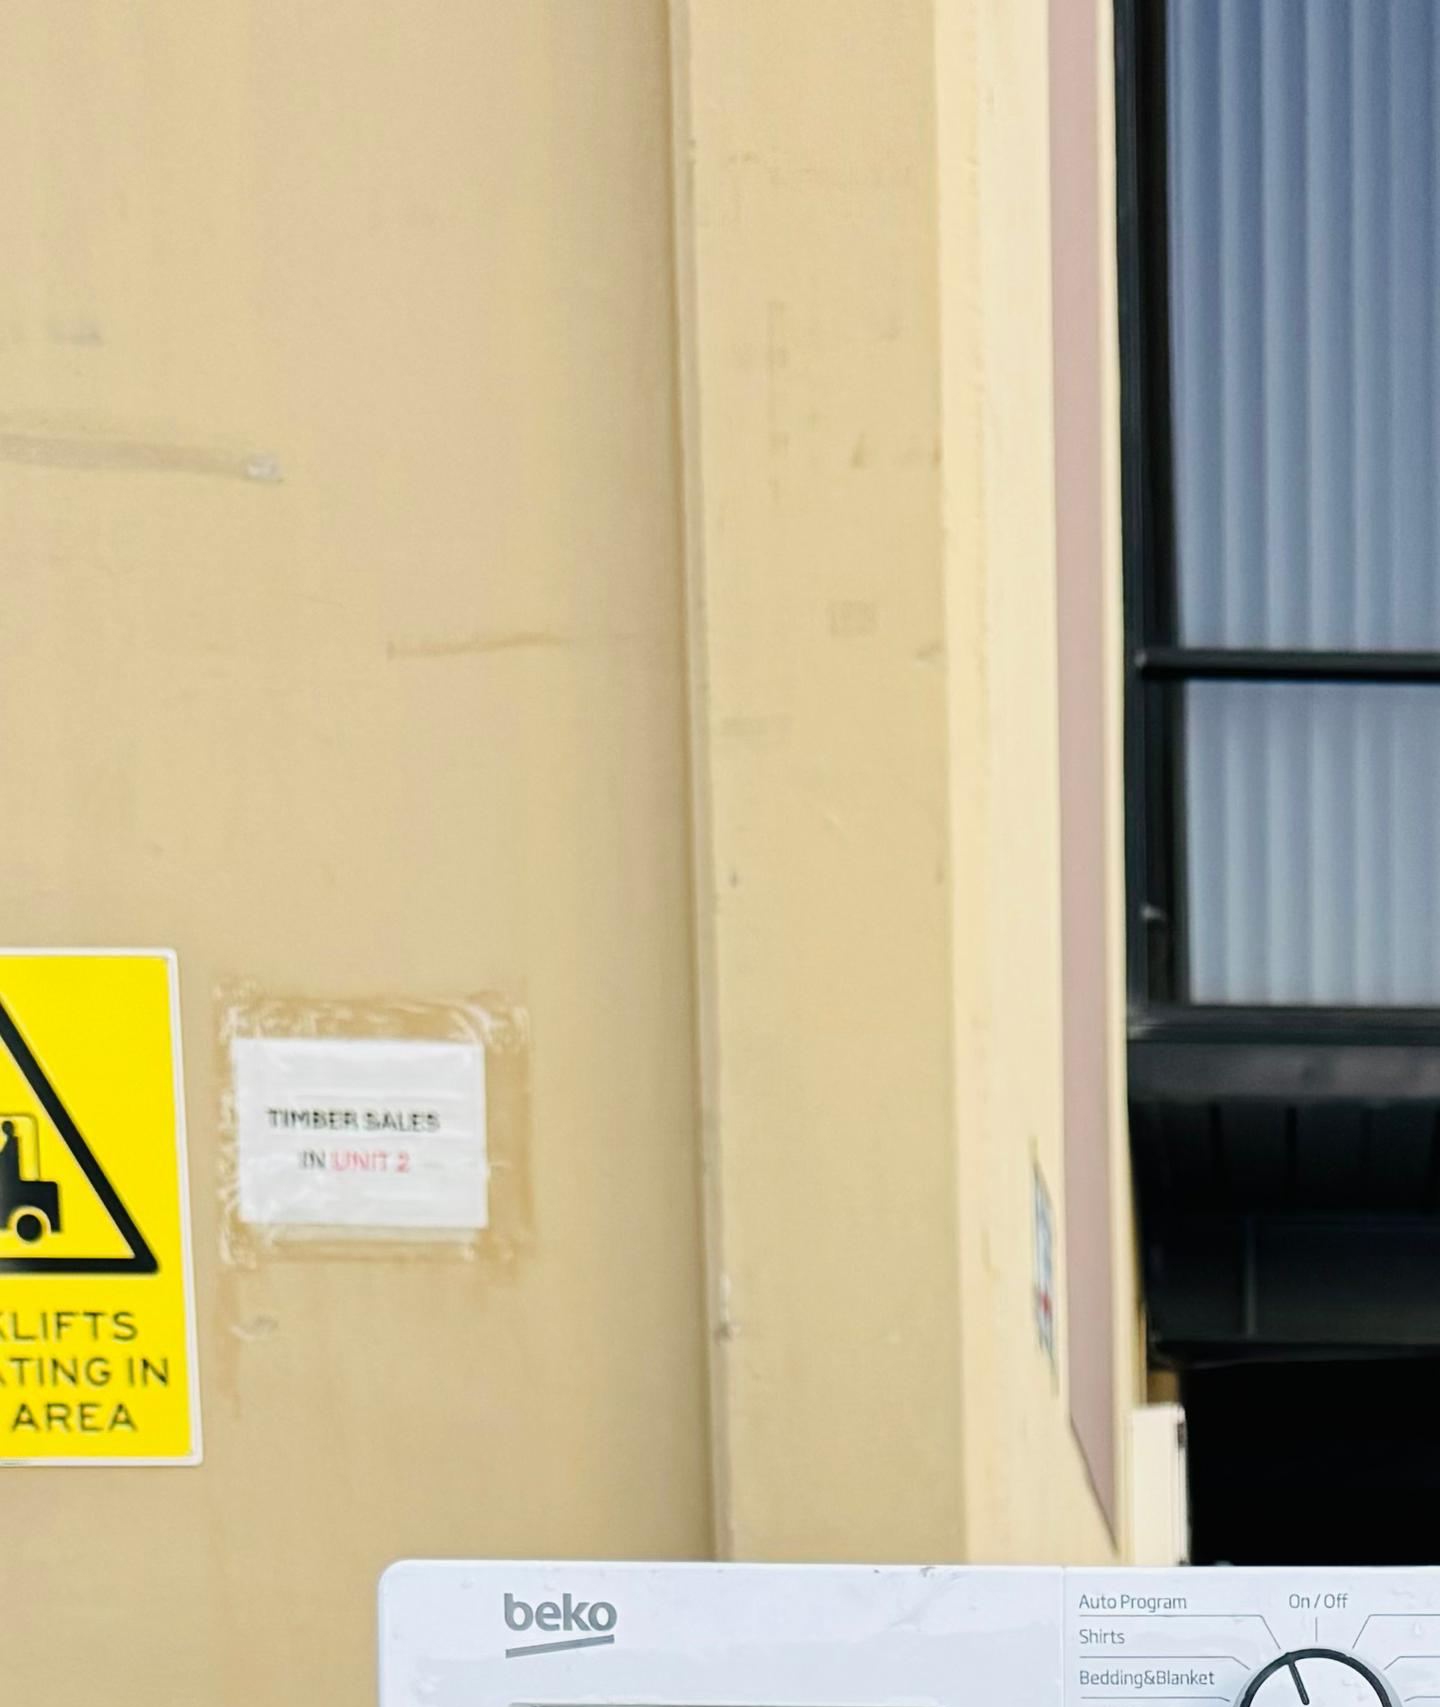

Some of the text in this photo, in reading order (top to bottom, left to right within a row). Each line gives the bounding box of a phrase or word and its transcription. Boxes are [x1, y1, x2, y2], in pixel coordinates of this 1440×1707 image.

[267, 1107, 441, 1132] TIMBER SALES
[302, 1150, 410, 1173] IN UNIT 2
[0, 1357, 168, 1386] TING IN
[11, 1403, 138, 1432] AREA
[1079, 1594, 1187, 1613] Auto Program
[1289, 1594, 1310, 1608] On
[1324, 1592, 1348, 1608] Off
[504, 1593, 617, 1631] beko
[1079, 1629, 1125, 1644] Shirts
[1079, 1669, 1215, 1688] Bedding&Blanket
